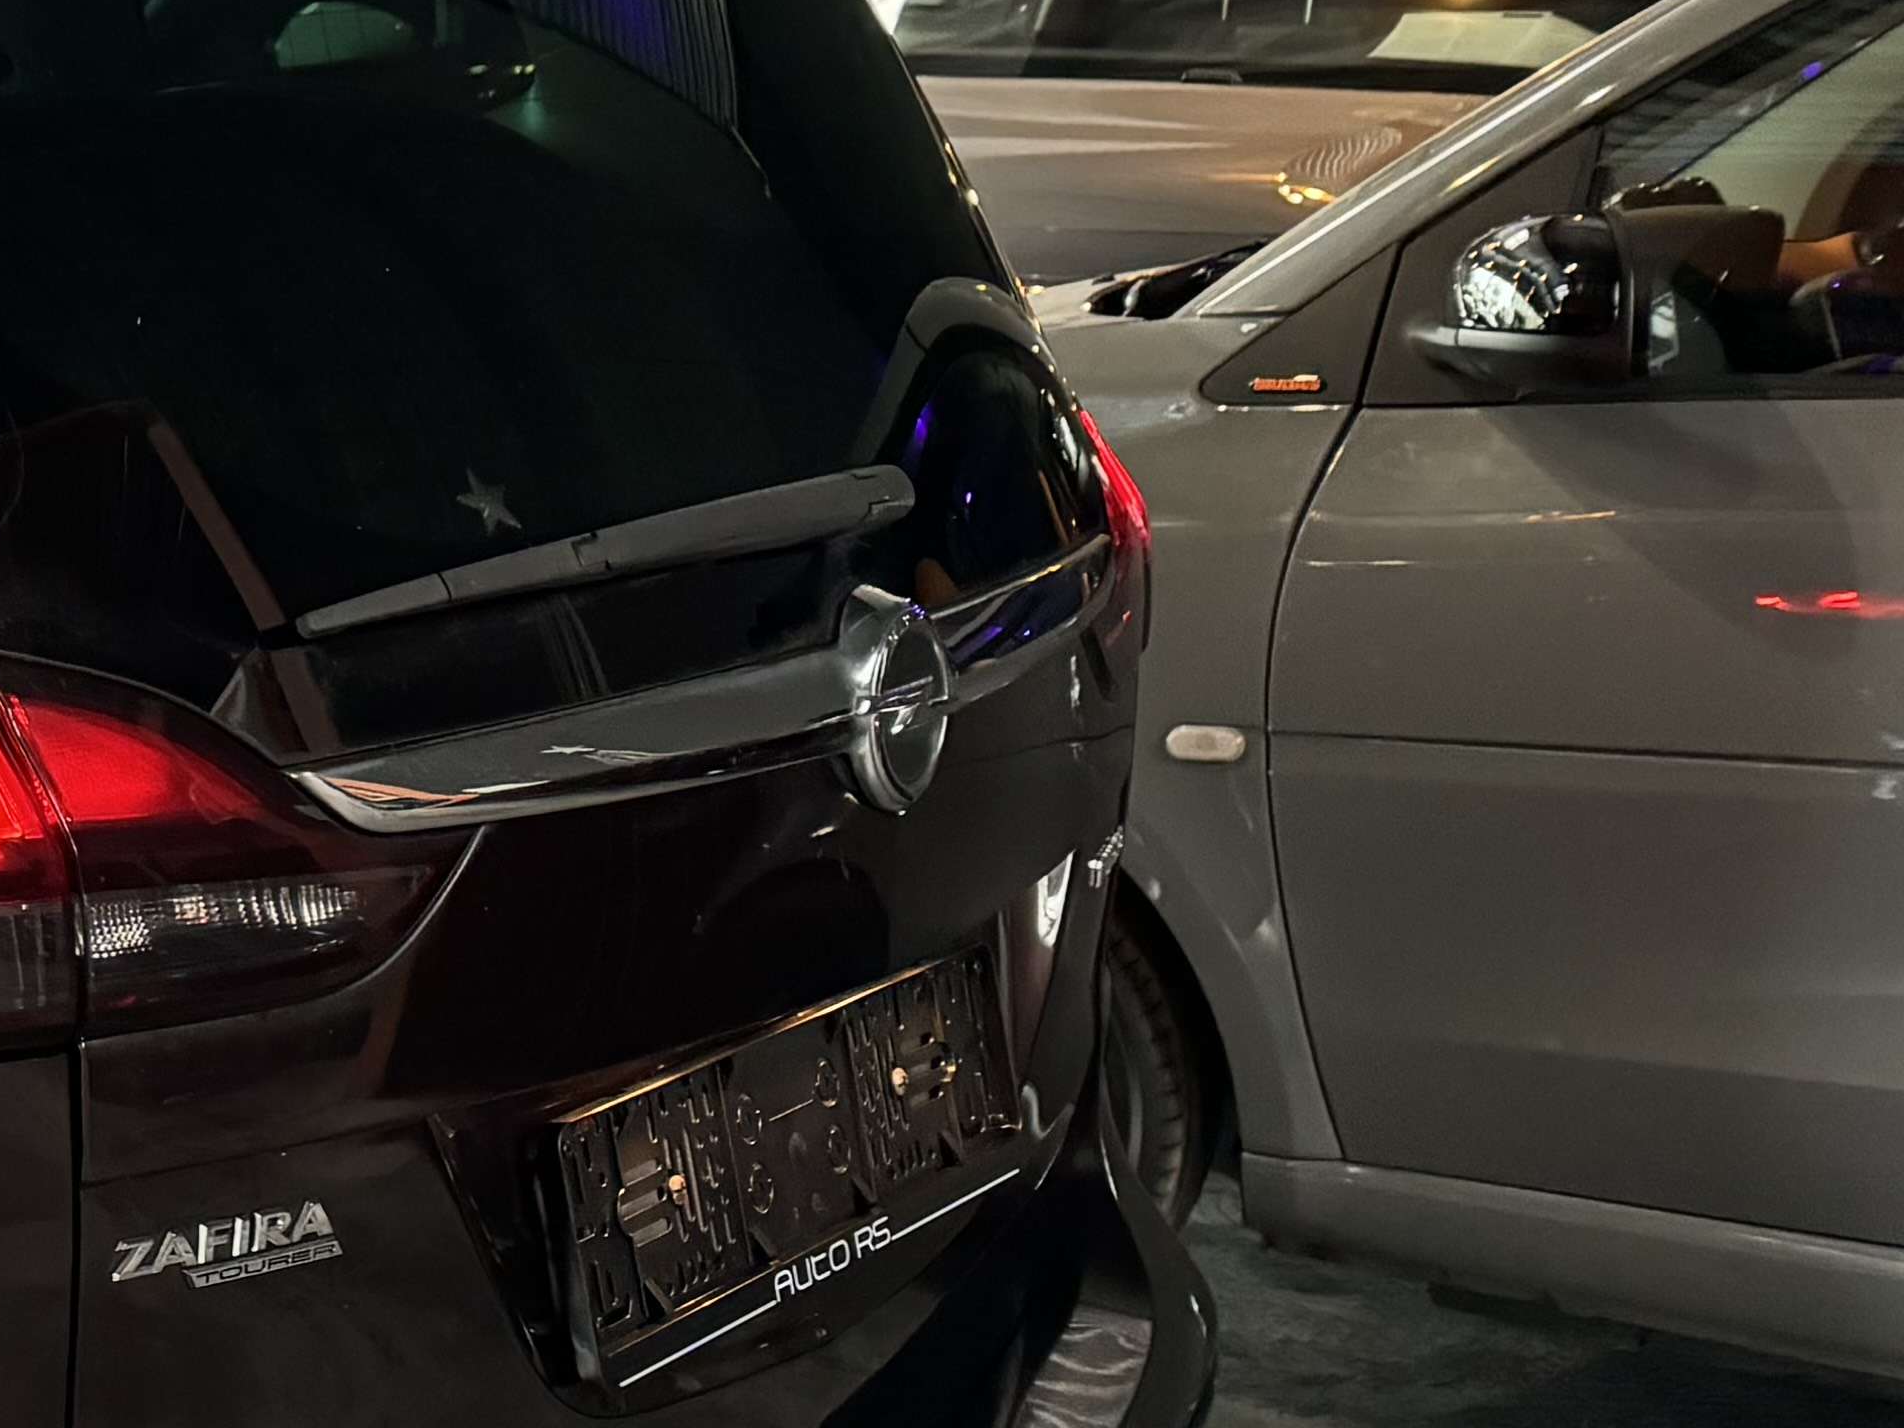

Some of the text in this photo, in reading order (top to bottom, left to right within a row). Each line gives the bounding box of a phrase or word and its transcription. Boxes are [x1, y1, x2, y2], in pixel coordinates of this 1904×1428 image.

[111, 1199, 334, 1282] ZAFIRA
[853, 1215, 892, 1259] RS
[196, 1244, 338, 1284] TOURER
